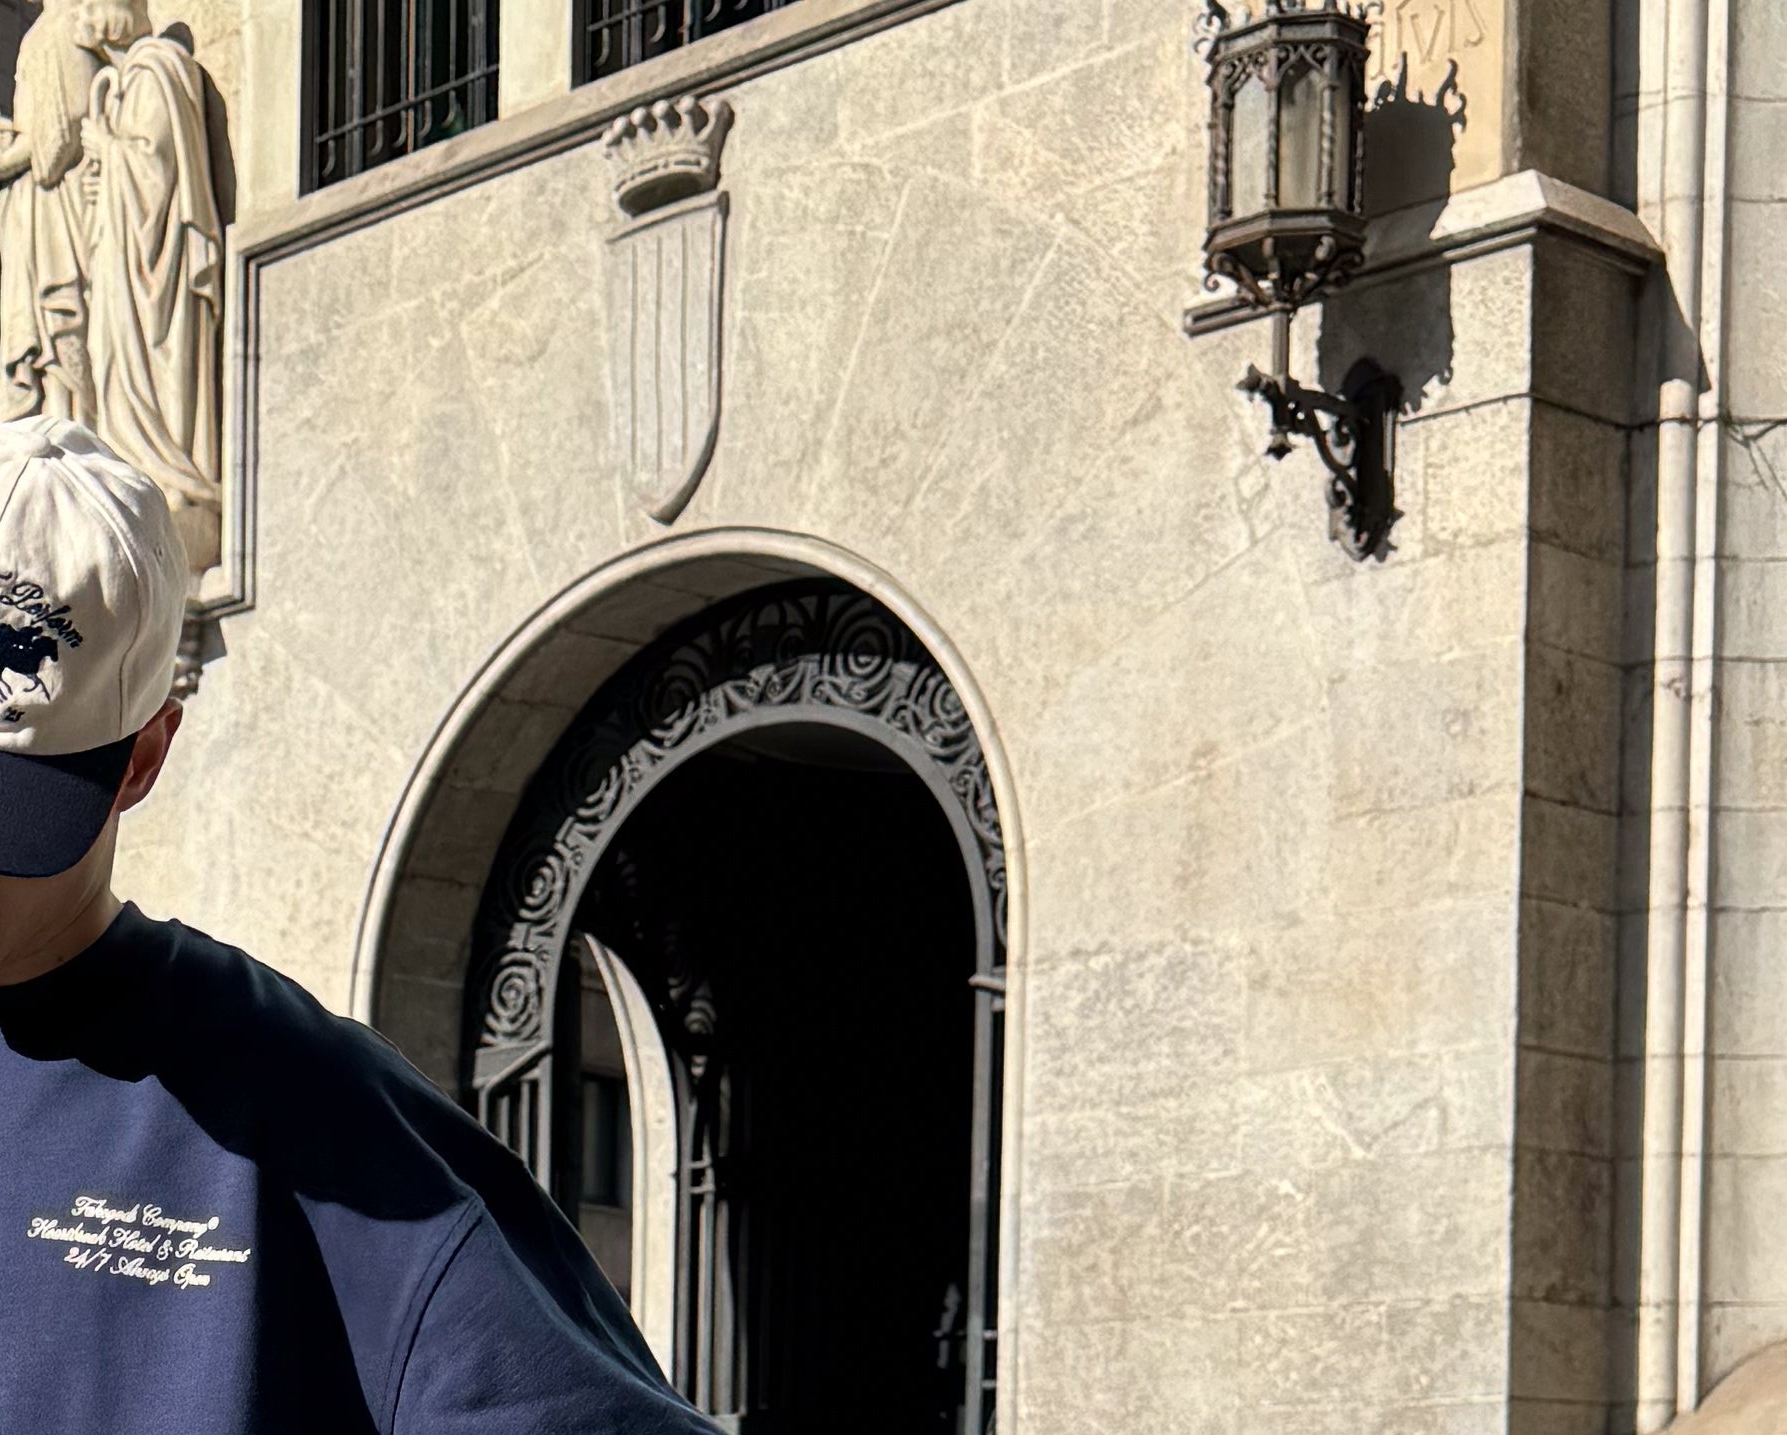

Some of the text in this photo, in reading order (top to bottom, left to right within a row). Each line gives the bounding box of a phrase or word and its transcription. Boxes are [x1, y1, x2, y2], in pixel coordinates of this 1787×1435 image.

[0, 582, 84, 648] Perform
[108, 1227, 161, 1253] Hotel
[156, 1239, 174, 1261] &
[64, 1246, 211, 1290] 24/7 Always Open
